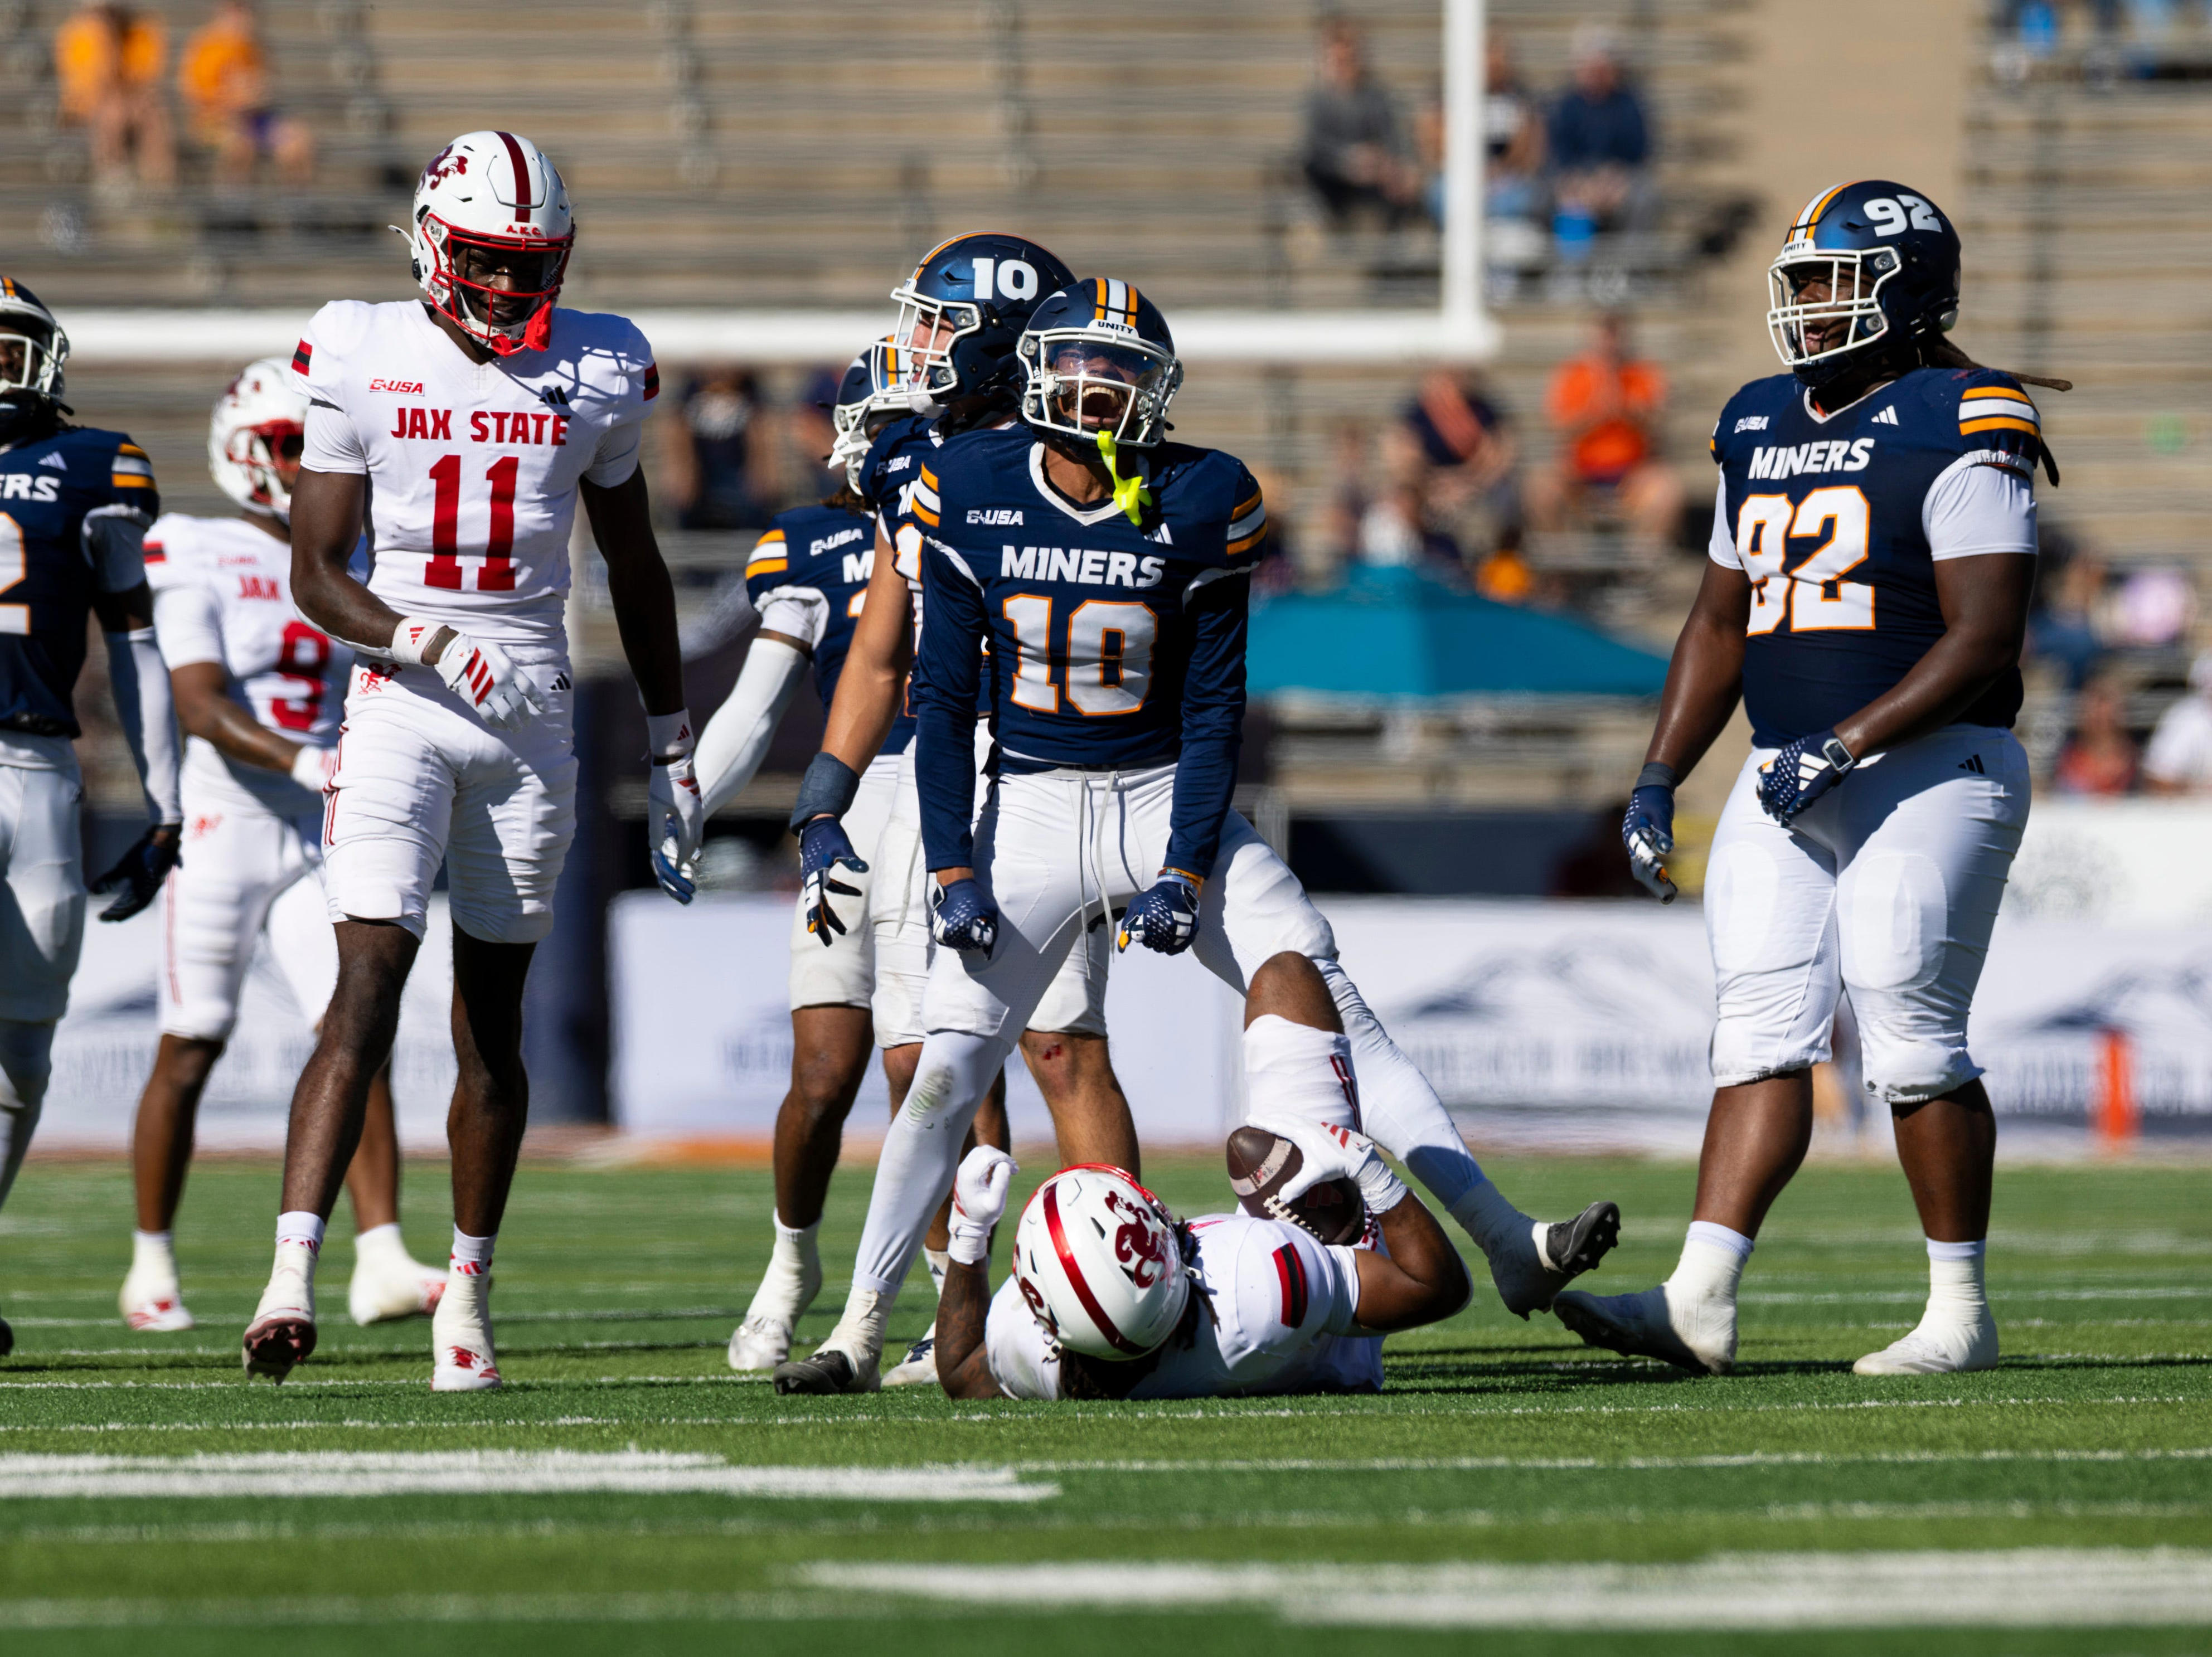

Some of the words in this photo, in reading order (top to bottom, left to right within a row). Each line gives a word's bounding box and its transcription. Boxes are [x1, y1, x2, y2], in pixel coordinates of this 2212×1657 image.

[1864, 195, 1942, 237] 92
[1784, 242, 1806, 253] UNITY
[972, 258, 1038, 301] 10
[1098, 321, 1134, 334] UNITY
[390, 407, 452, 440] JAX
[470, 411, 571, 445] STATE
[1748, 438, 1875, 480] MINERS
[0, 474, 61, 501] RS
[424, 455, 519, 590] 11
[1001, 545, 1166, 587] MINERS
[1736, 485, 1876, 637] 92
[239, 574, 281, 601] JAX
[270, 619, 331, 732] 9
[1003, 593, 1158, 716] 10
